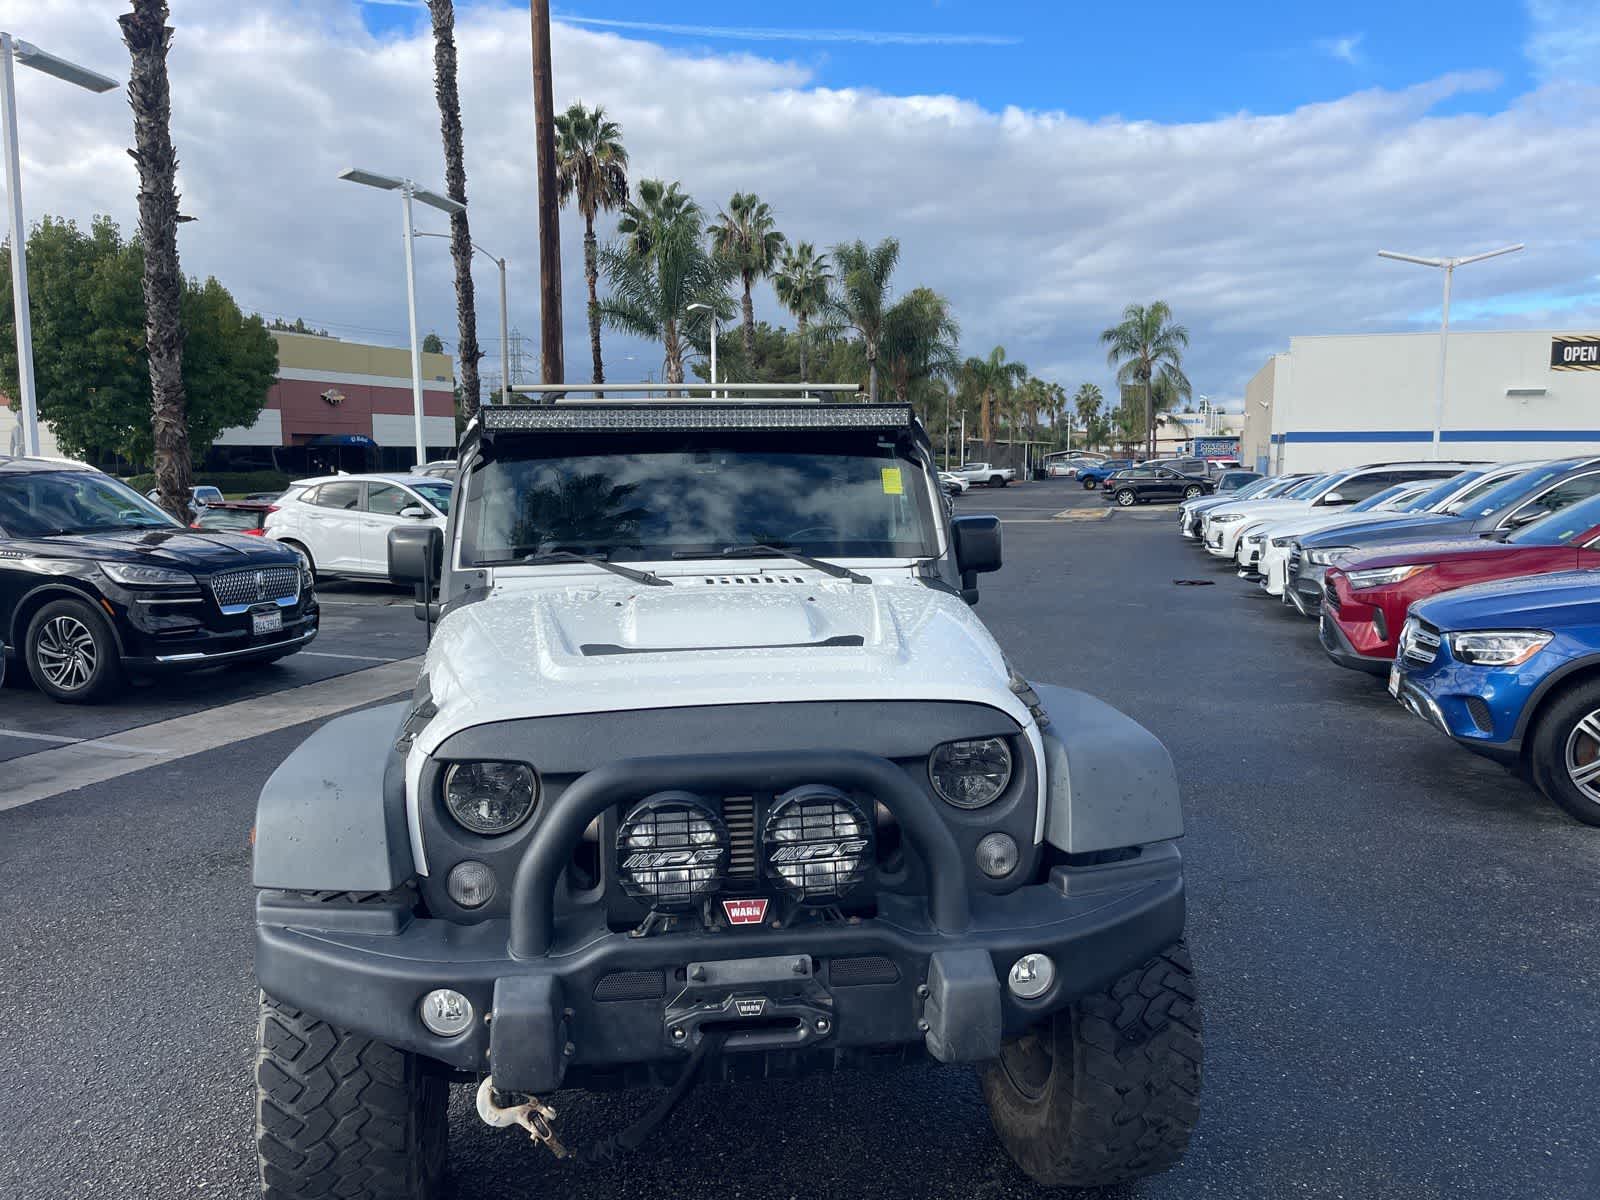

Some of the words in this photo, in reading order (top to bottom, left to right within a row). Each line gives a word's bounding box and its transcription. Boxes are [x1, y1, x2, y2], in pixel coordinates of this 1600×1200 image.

[1563, 346, 1598, 362] OPEN
[730, 906, 761, 918] WARN
[740, 1004, 760, 1012] WARN
